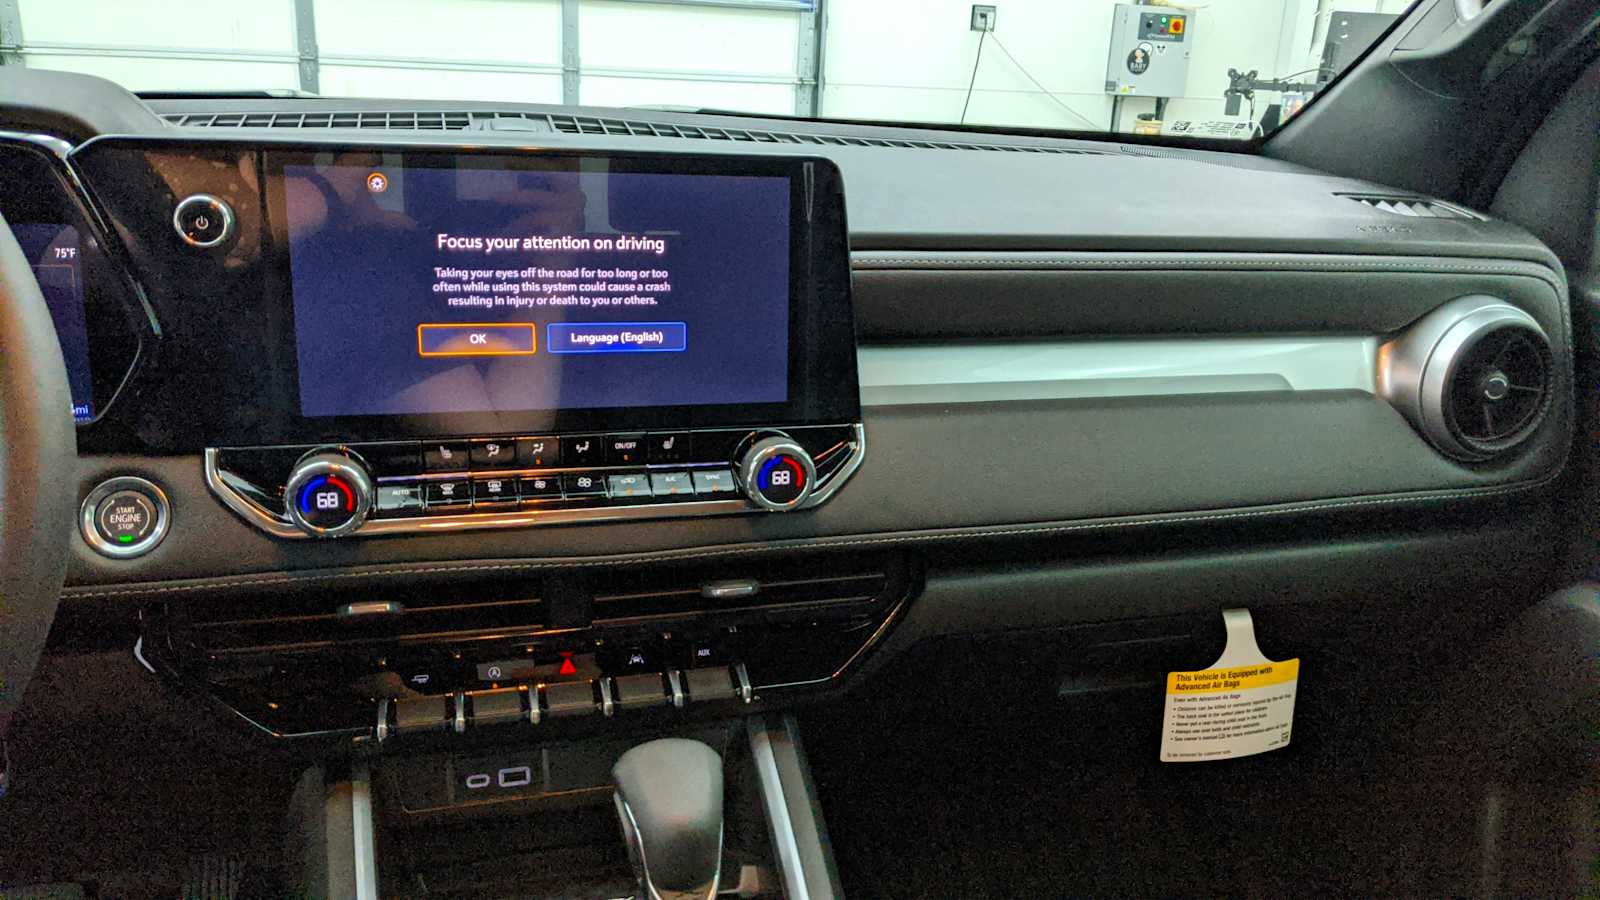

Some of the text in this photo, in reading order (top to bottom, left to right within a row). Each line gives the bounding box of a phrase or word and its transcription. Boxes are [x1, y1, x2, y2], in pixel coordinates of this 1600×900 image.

[437, 233, 665, 254] Focus your attention on driving
[54, 247, 77, 259] 75°F
[434, 266, 669, 280] Taking your eyes off the road for too long or too
[432, 281, 671, 294] often while using this system could cause a crash
[448, 294, 658, 308] resulting in injury or death to you or others.
[469, 333, 487, 344] OK
[570, 331, 664, 345] Language (English)
[614, 441, 637, 450] ON/OFF
[771, 470, 791, 485] 68
[391, 489, 410, 497] AUTO
[316, 492, 339, 509] 68
[115, 506, 135, 514] START
[110, 513, 142, 524] ENGINE
[117, 523, 135, 531] STOP
[697, 648, 710, 657] AUX
[1177, 666, 1273, 682] This Vehicle is Equipped with
[1176, 679, 1240, 691] Advanced Air Bags
